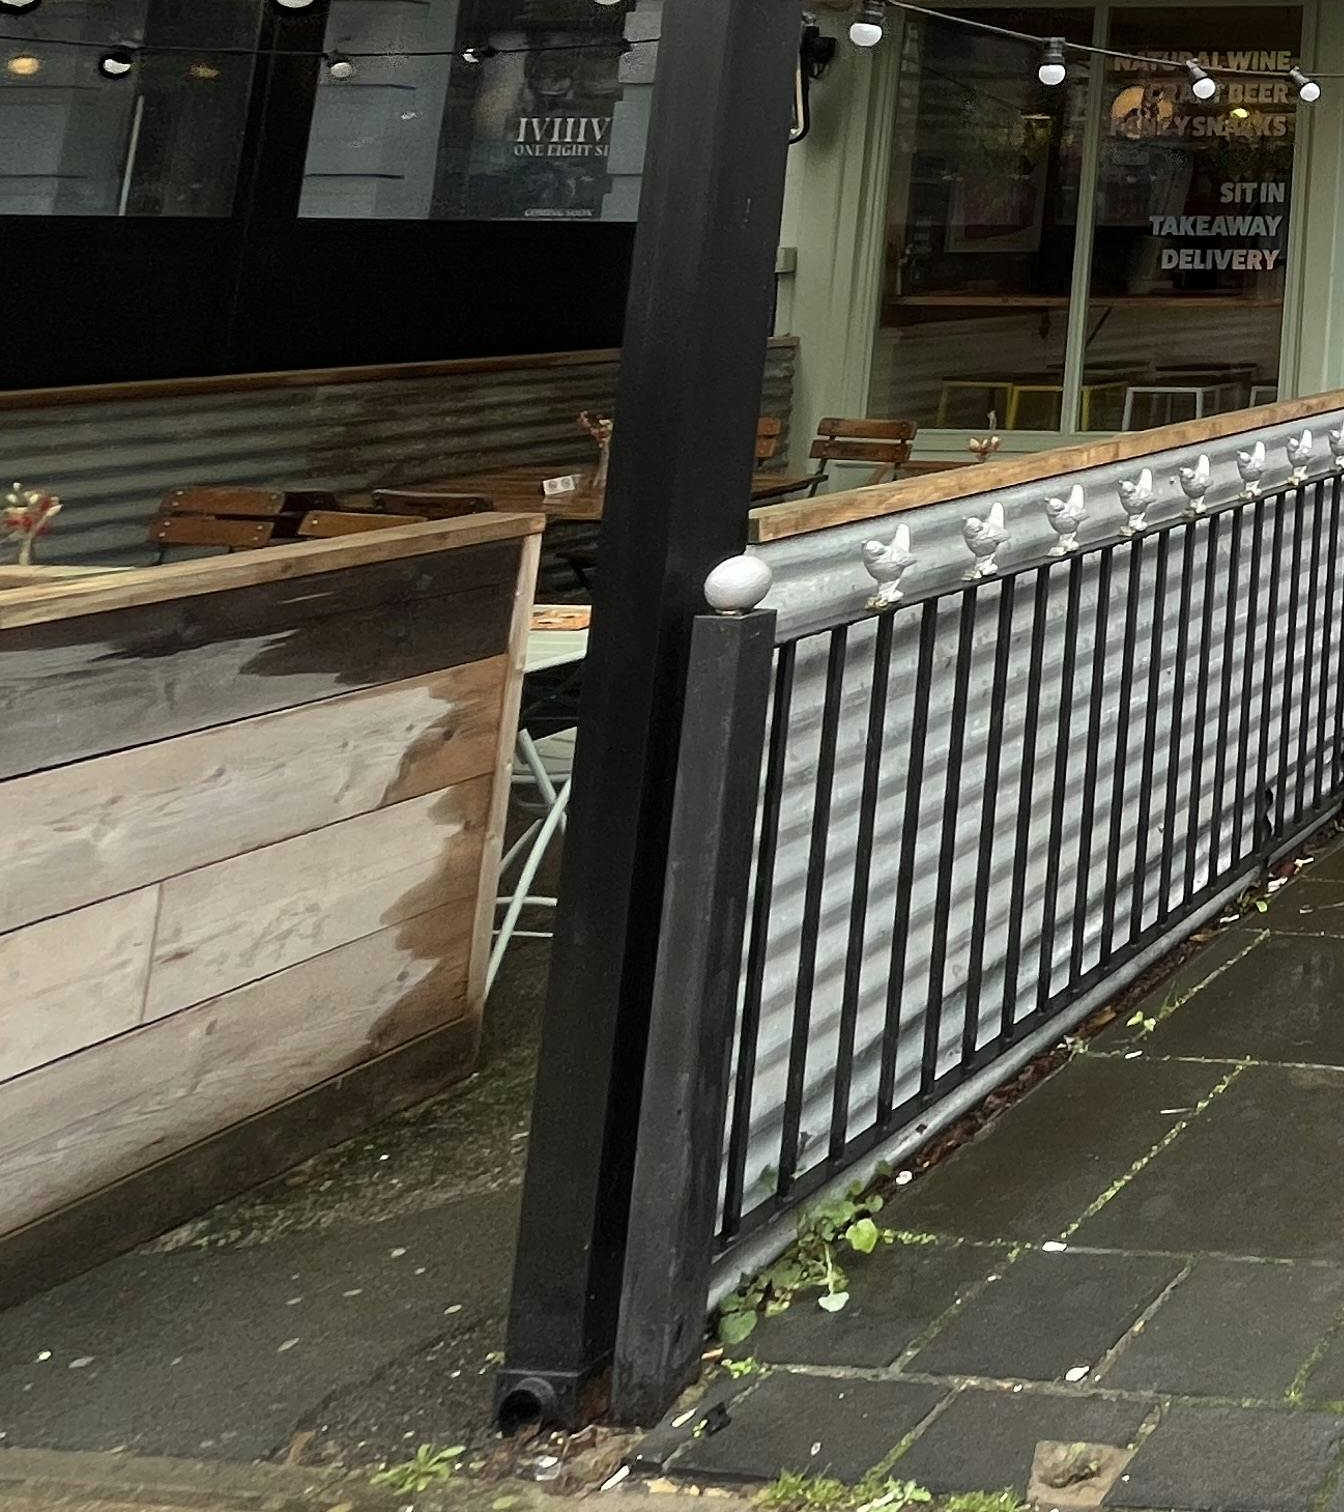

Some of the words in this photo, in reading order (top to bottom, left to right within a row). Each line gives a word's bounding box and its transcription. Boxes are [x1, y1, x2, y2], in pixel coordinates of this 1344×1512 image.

[1226, 50, 1293, 71] WINE
[1228, 83, 1290, 104] BEER
[513, 144, 544, 156] ONE
[546, 144, 593, 156] EIGHT
[1220, 182, 1259, 203] SIT
[1260, 182, 1286, 203] IN
[1149, 215, 1284, 237] TAKEAWAY
[1161, 249, 1282, 270] DELIVERY
